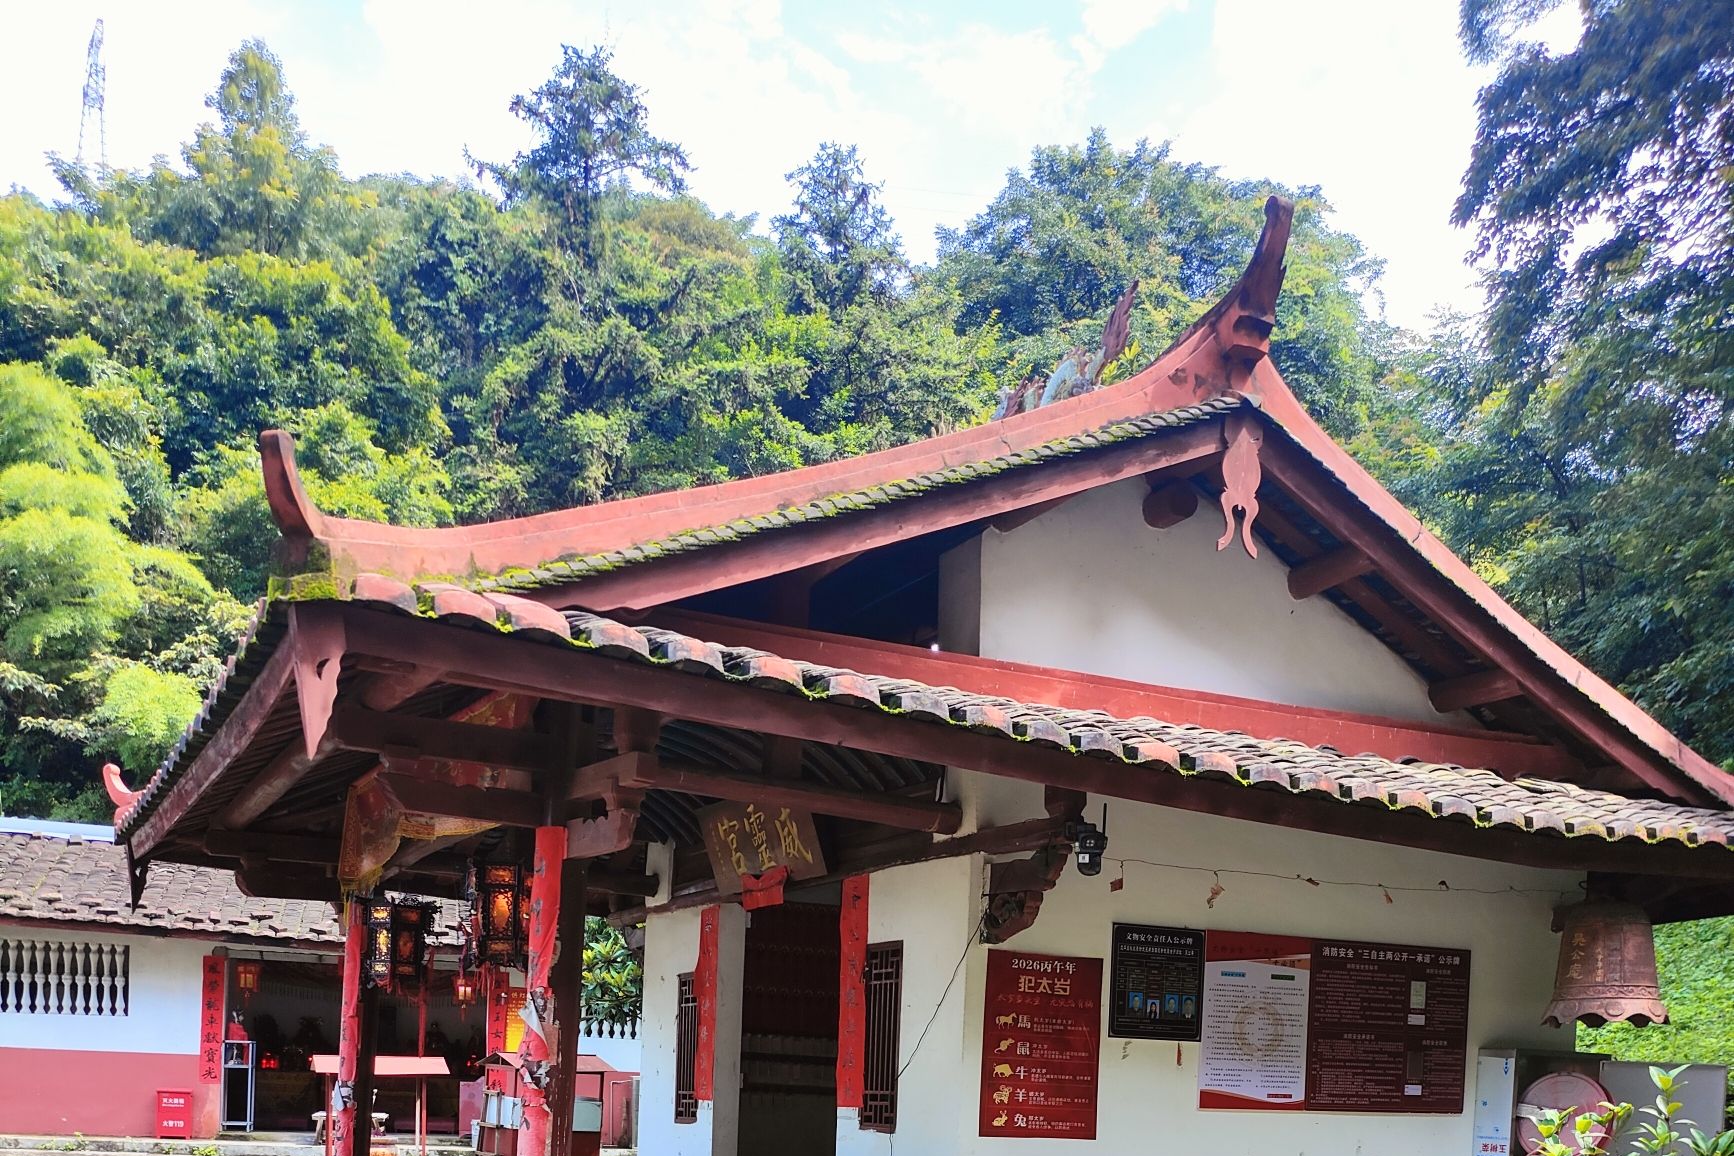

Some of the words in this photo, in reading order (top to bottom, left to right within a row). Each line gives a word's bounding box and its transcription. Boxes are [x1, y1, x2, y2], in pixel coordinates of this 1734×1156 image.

[1126, 932, 1193, 945] 文物安全责任人公示牌
[1011, 959, 1077, 974] 2026丙午年
[1018, 975, 1071, 995] 犯太岁
[1017, 1014, 1031, 1029] 馬
[1016, 1041, 1030, 1056] 鼠
[1015, 1066, 1028, 1080] 牛
[1014, 1088, 1028, 1103] 羊
[1014, 1113, 1027, 1127] 兔
